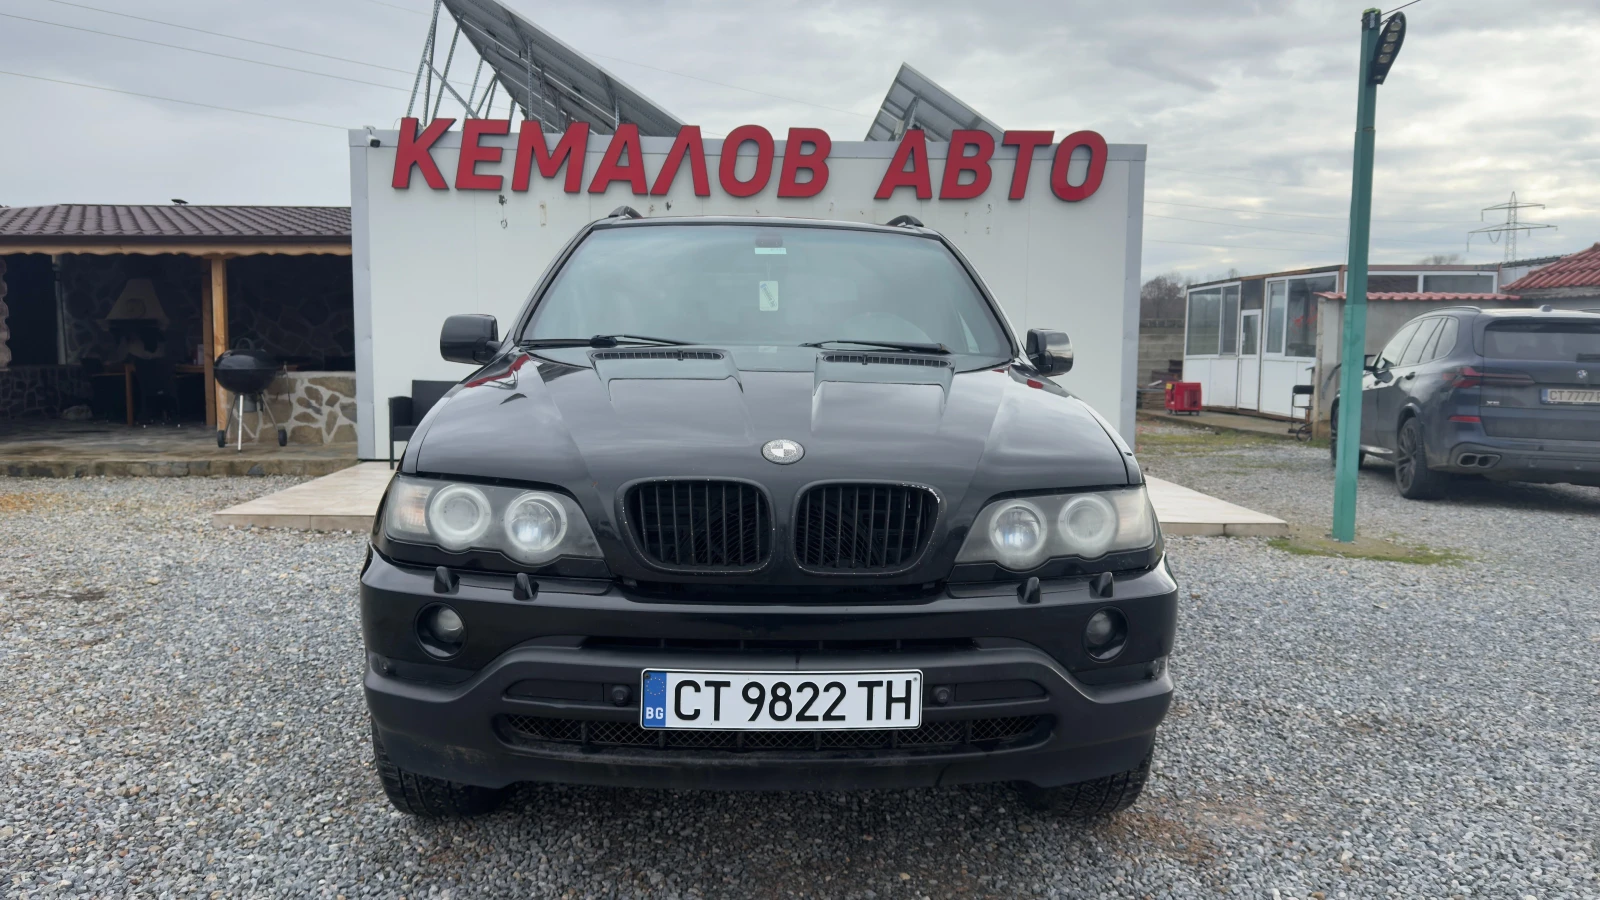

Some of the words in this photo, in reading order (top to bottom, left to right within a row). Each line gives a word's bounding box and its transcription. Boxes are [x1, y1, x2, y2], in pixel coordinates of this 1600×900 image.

[391, 117, 832, 199] КЕМАЛОВ
[873, 129, 1108, 202] АВТО
[1549, 390, 1565, 401] CT
[1567, 390, 1595, 402] 7777
[645, 706, 664, 720] BG
[674, 679, 731, 722] CT
[741, 680, 847, 722] 9822
[857, 679, 912, 721] TH
